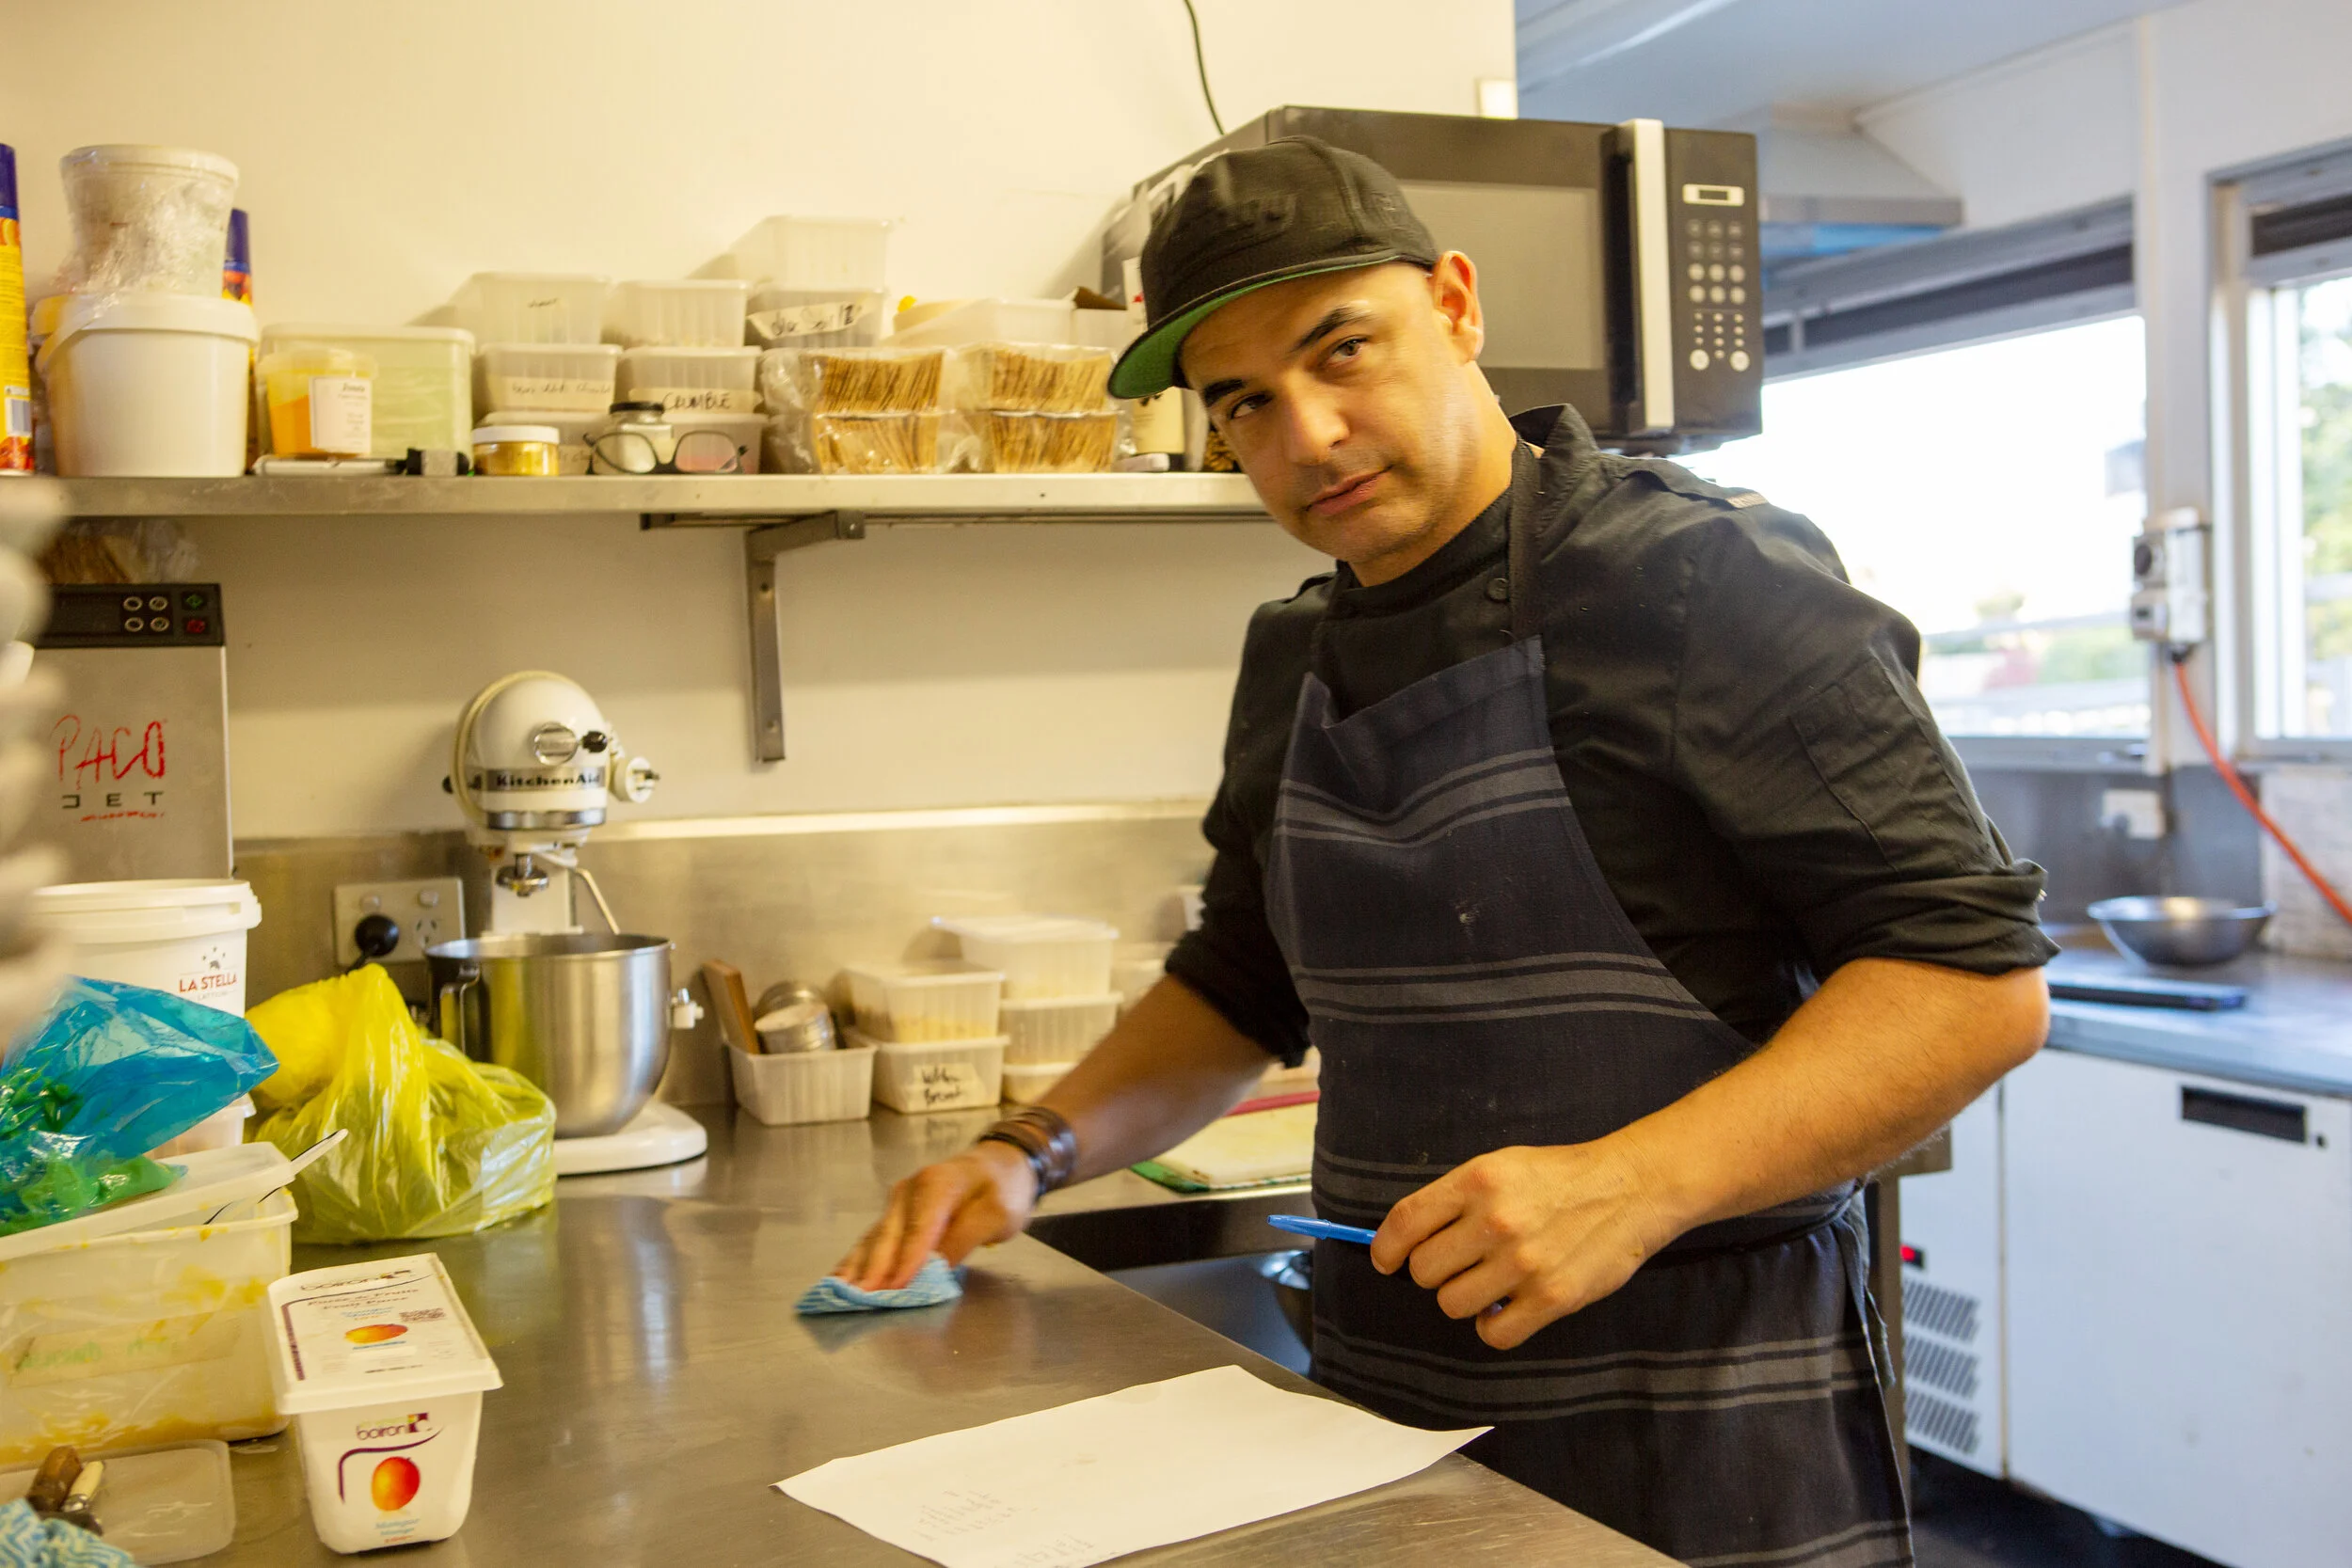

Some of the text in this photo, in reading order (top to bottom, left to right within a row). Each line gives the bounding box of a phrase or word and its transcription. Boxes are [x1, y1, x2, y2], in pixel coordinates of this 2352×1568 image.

[49, 714, 166, 790] PACO
[61, 791, 164, 809] JET
[179, 973, 238, 993] LA STELLA
